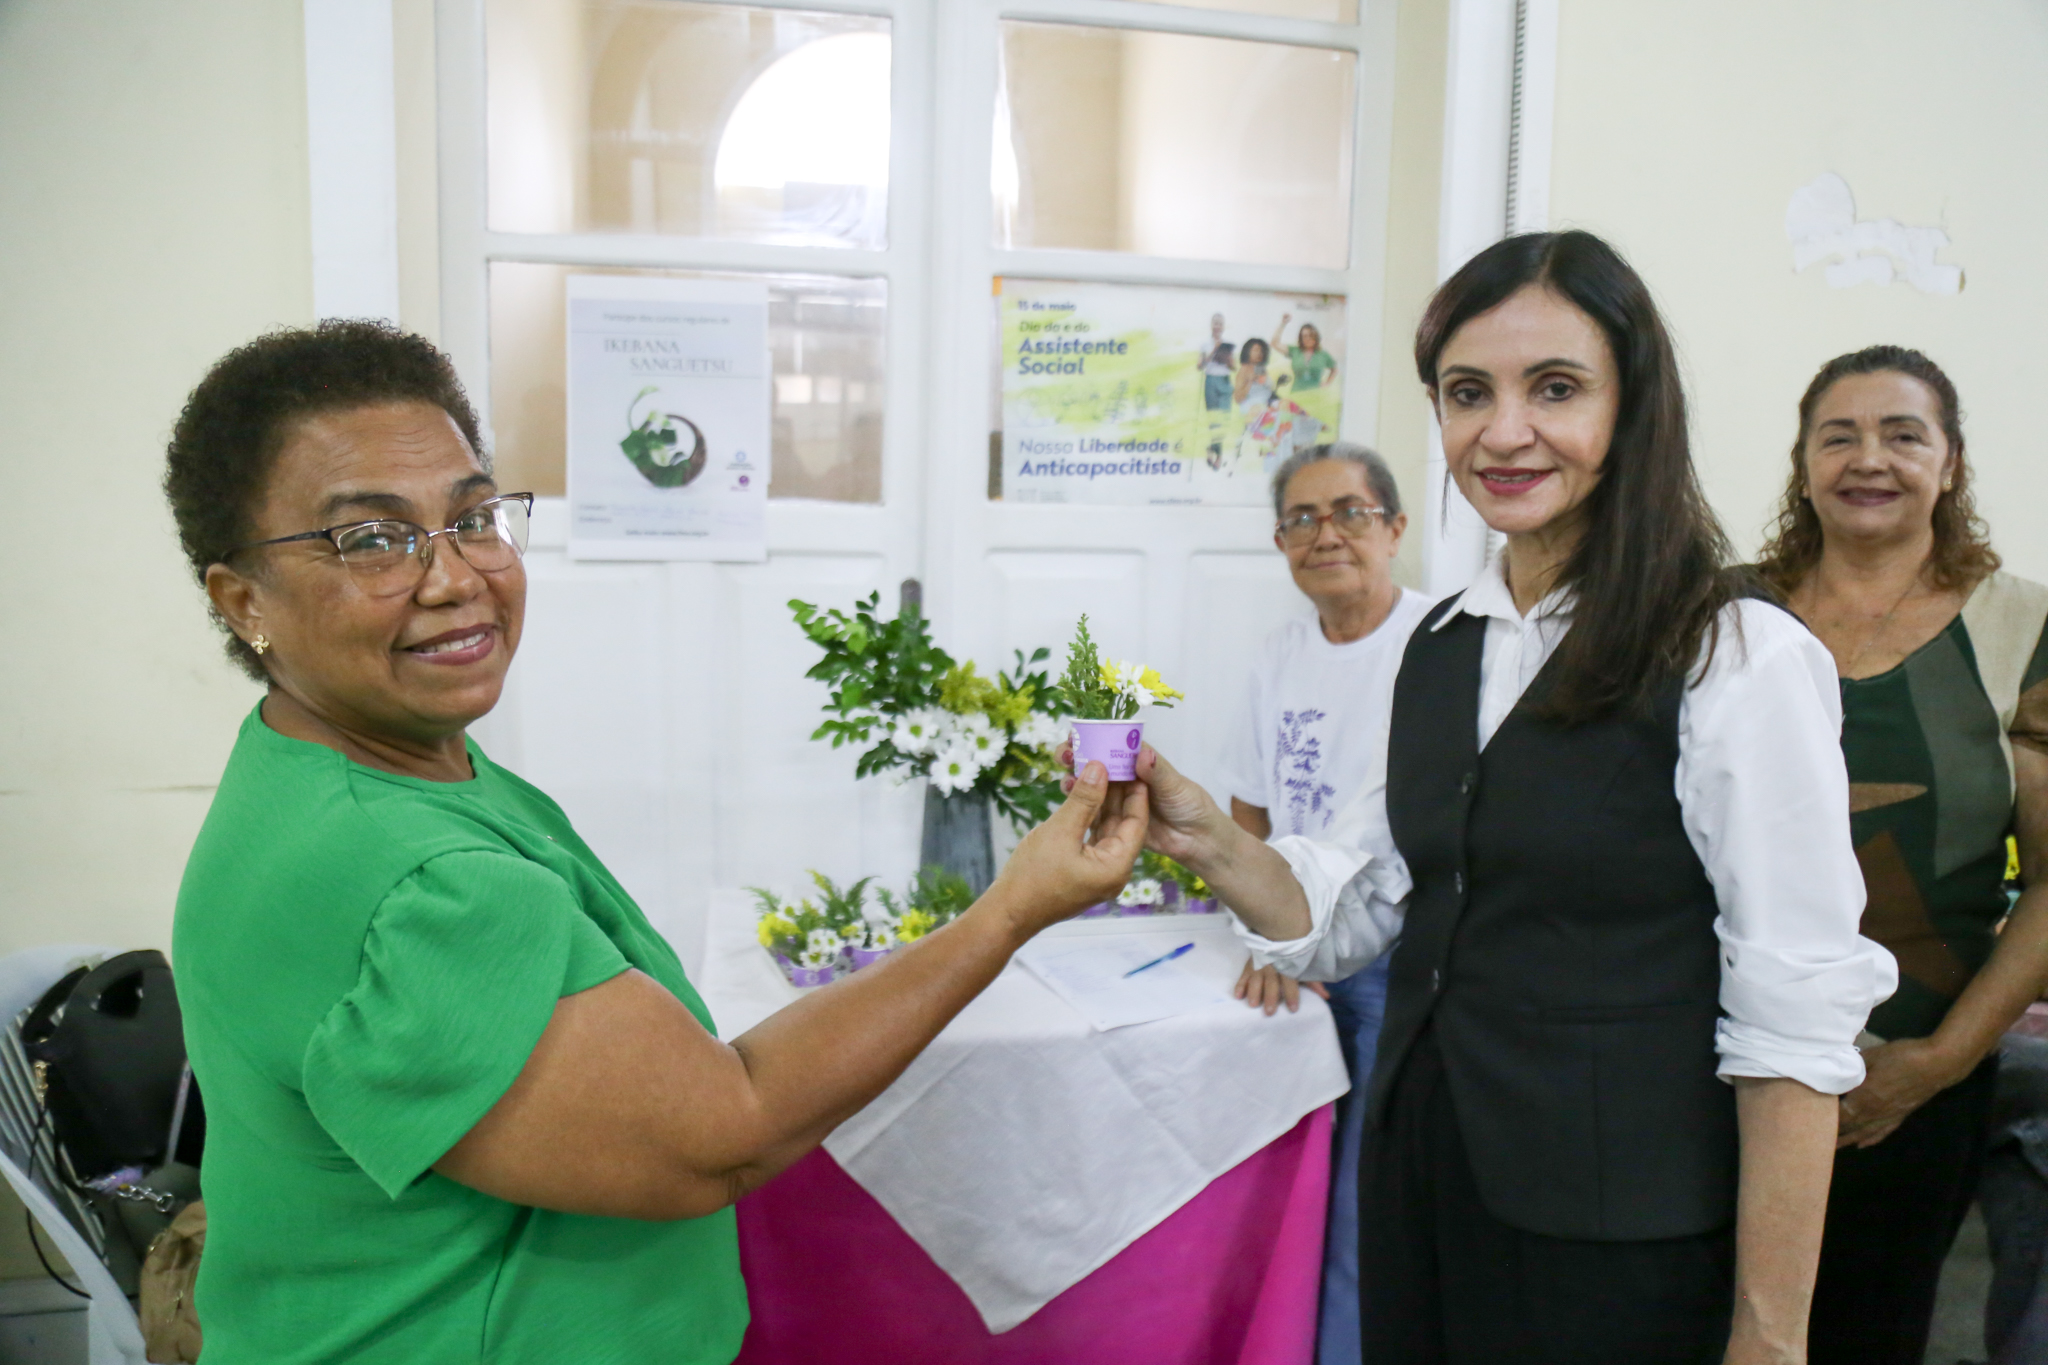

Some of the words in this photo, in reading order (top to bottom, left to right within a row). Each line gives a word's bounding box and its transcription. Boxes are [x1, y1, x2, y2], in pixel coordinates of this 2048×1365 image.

[1018, 301, 1028, 311] 15
[1032, 301, 1045, 311] de
[1050, 301, 1077, 311] maio
[1020, 321, 1041, 332] Dia
[1063, 323, 1071, 332] e
[604, 339, 680, 354] IKEBANA
[1018, 336, 1128, 355] Assistente
[630, 357, 733, 373] SANGUETSU
[1018, 357, 1084, 375] Social
[1019, 439, 1073, 454] Nossa
[1079, 437, 1169, 454] Liberdade
[1019, 457, 1181, 480] Anticapacitista
